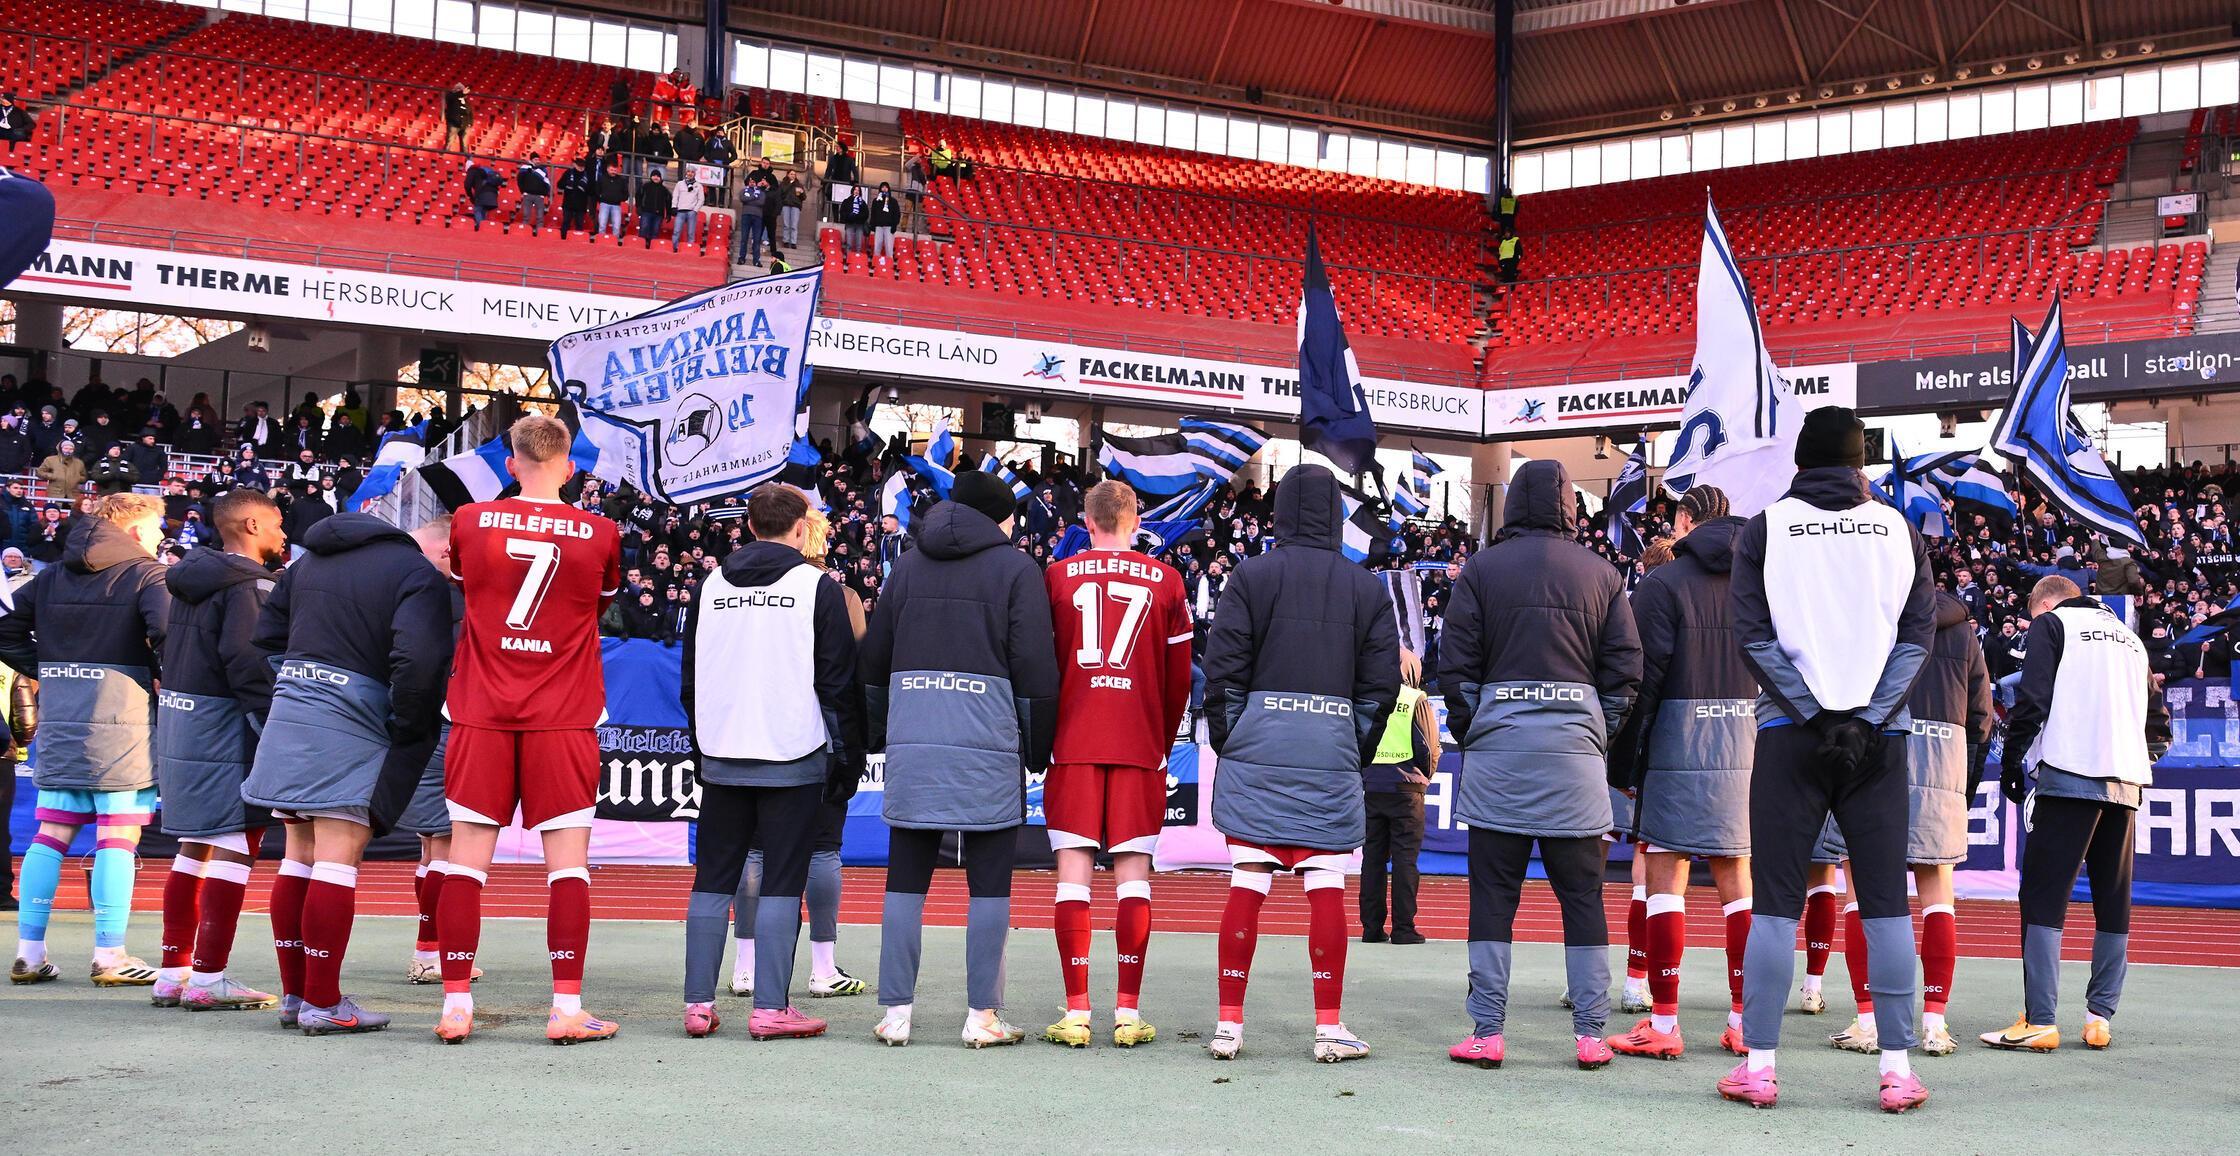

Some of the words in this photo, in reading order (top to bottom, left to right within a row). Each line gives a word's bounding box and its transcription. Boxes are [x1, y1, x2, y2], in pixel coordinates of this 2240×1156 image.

[157, 264, 289, 296] THERME
[303, 280, 454, 312] HERSBRUCK
[483, 297, 560, 322] MEINE
[938, 341, 998, 366] LAND
[1079, 357, 1245, 391] FACKELMANN
[1363, 387, 1469, 415] HERSBRUCK
[1915, 370, 1973, 390] Mehr
[1979, 366, 2011, 385] als
[479, 511, 594, 539] BIELEFELD
[1788, 517, 1888, 537] SCHÜCO
[1066, 558, 1164, 583] BIELEFELD
[505, 537, 561, 631] 7
[713, 590, 795, 610] SCHÜCO
[1072, 581, 1154, 670] 17
[500, 636, 553, 653] KANIA
[40, 663, 105, 680] SCHÜCO
[901, 672, 986, 694] SCHÜCO
[1090, 675, 1132, 690] SICKER
[1495, 683, 1584, 701] SCHÜCO
[1264, 695, 1351, 717] SCHÜCO
[276, 940, 303, 948] DSC
[304, 946, 329, 958] DSC
[1810, 941, 1830, 949] DSC
[446, 951, 475, 960] DSC
[550, 950, 575, 960] DSC
[1118, 954, 1139, 964] DSC
[1223, 968, 1246, 978] DSC
